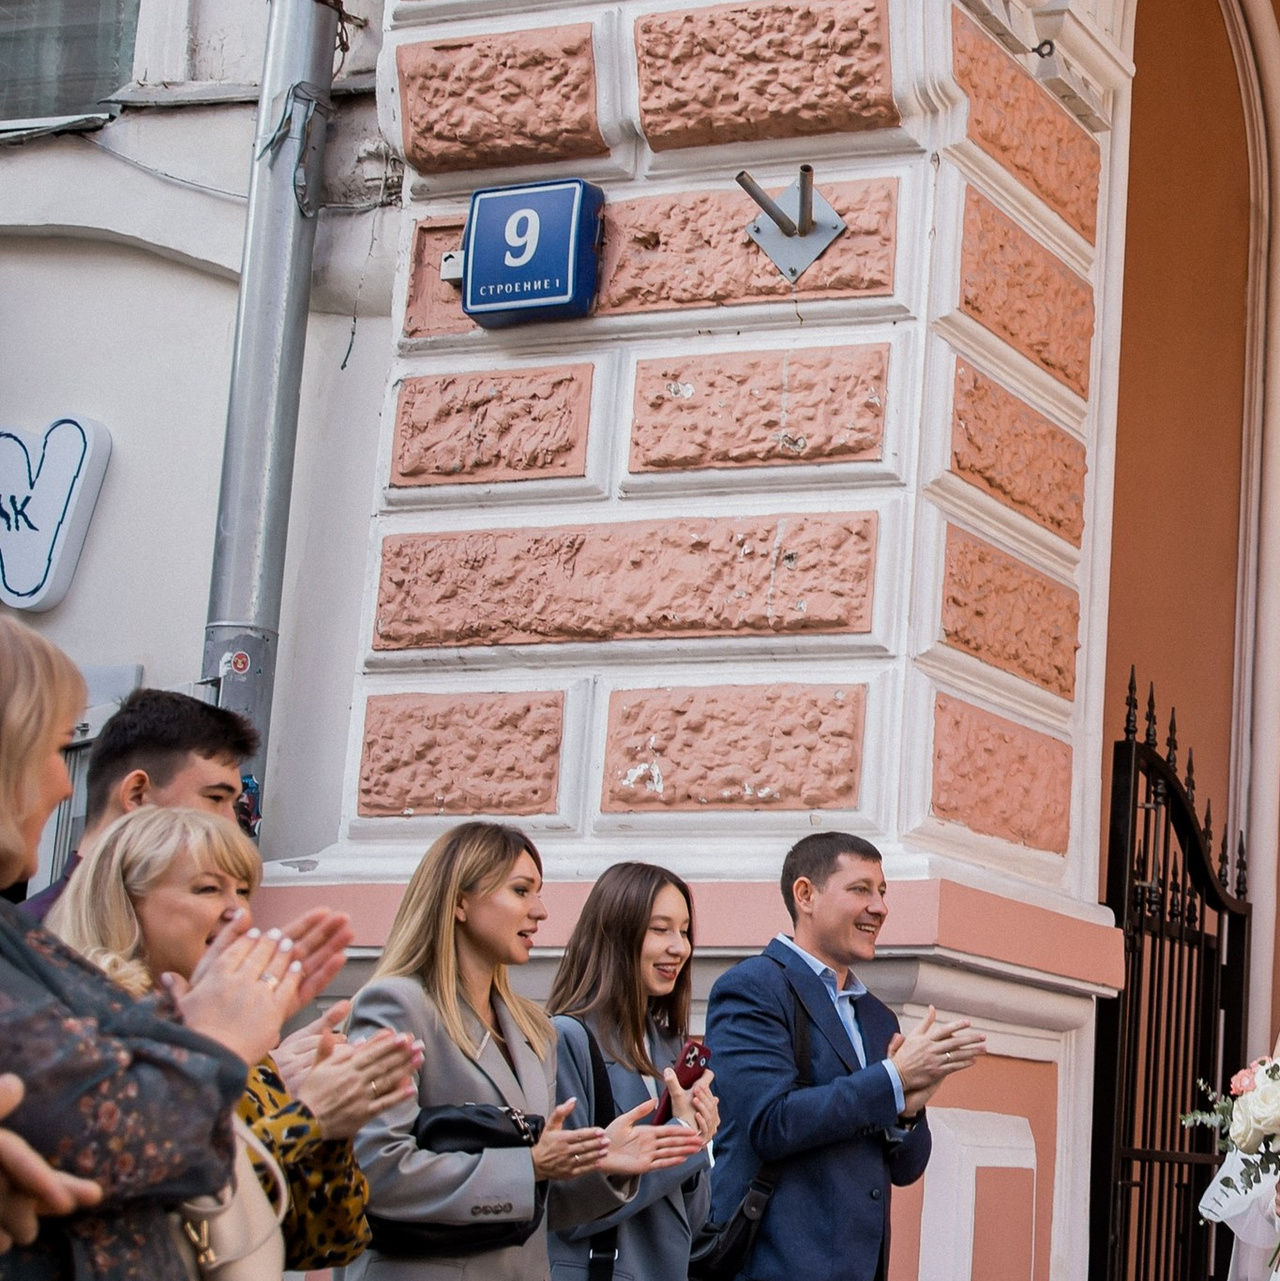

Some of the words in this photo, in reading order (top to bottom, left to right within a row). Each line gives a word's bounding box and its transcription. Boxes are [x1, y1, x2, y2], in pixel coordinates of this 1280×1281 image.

[504, 208, 540, 267] 9
[479, 279, 550, 296] СТРОЕНИЕ
[555, 278, 560, 288] 1
